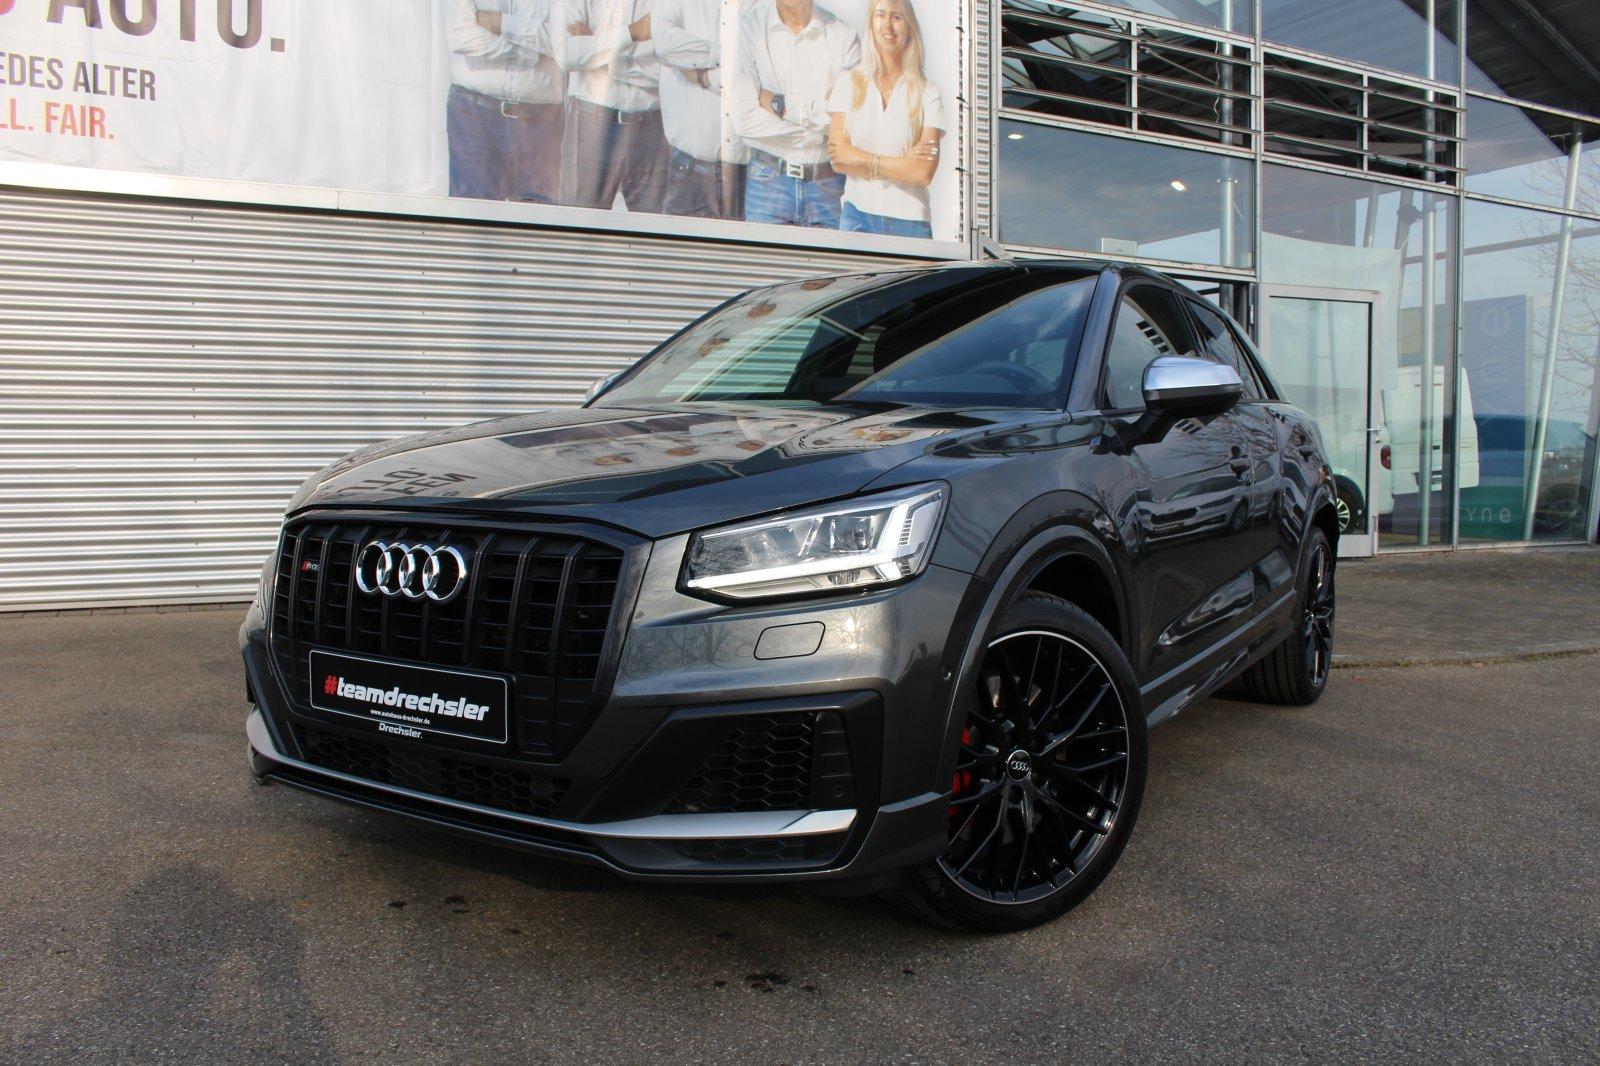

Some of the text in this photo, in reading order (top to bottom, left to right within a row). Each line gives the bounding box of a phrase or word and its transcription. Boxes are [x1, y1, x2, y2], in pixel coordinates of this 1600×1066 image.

[72, 61, 156, 101] ALTER
[0, 98, 115, 140] L. FAIR.
[323, 675, 490, 721] #teamdrechsler
[378, 722, 423, 739] Drechsler.
